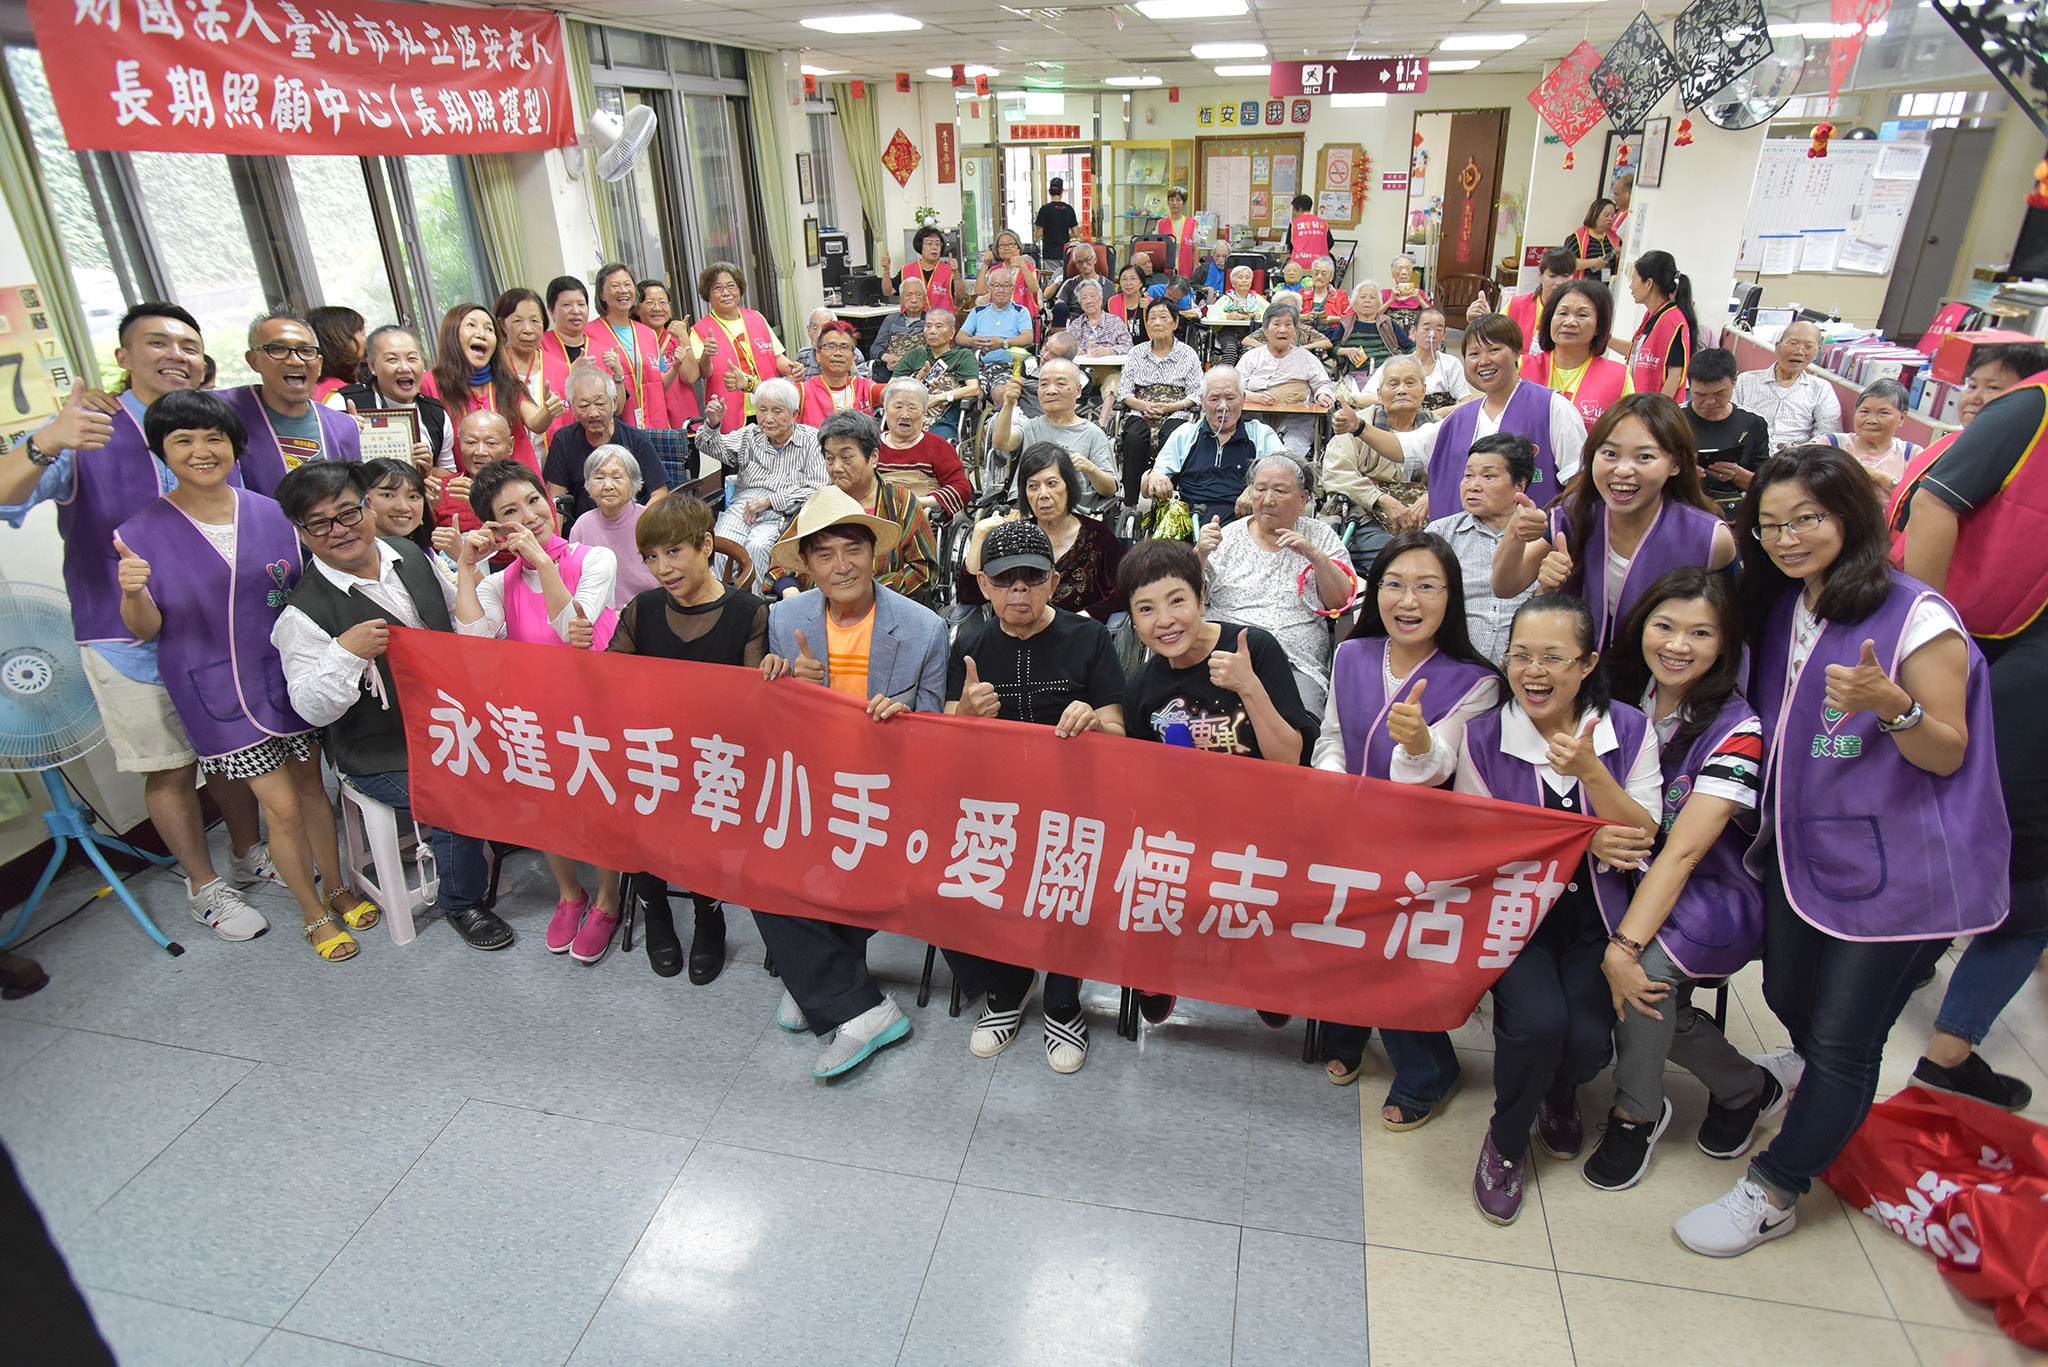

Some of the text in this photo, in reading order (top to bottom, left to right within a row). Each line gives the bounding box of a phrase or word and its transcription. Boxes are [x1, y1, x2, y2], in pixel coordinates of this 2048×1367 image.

[110, 59, 551, 139] 長期照顧中心(長期照護型)
[1303, 86, 1321, 94] 出口
[1810, 734, 1863, 758] 永達
